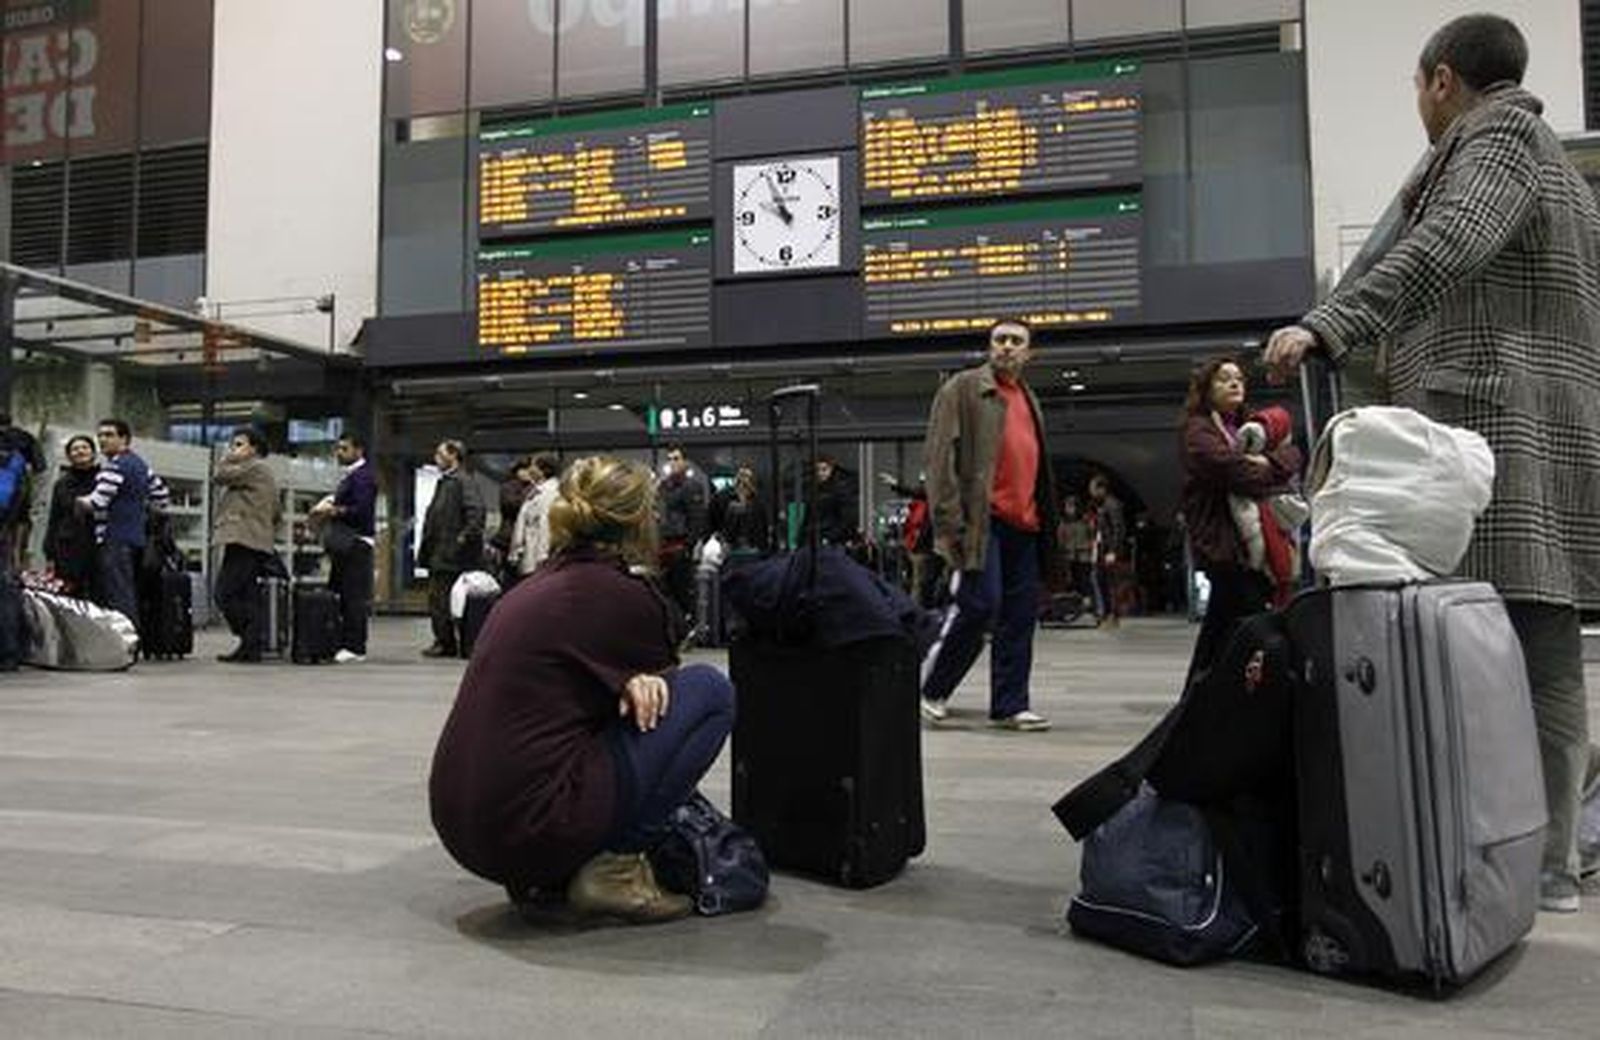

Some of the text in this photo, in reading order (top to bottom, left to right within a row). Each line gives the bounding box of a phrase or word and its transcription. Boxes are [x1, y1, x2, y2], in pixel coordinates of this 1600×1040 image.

[776, 170, 796, 184] 12
[742, 211, 755, 226] 9
[817, 205, 831, 220] 3
[779, 245, 793, 261] 6
